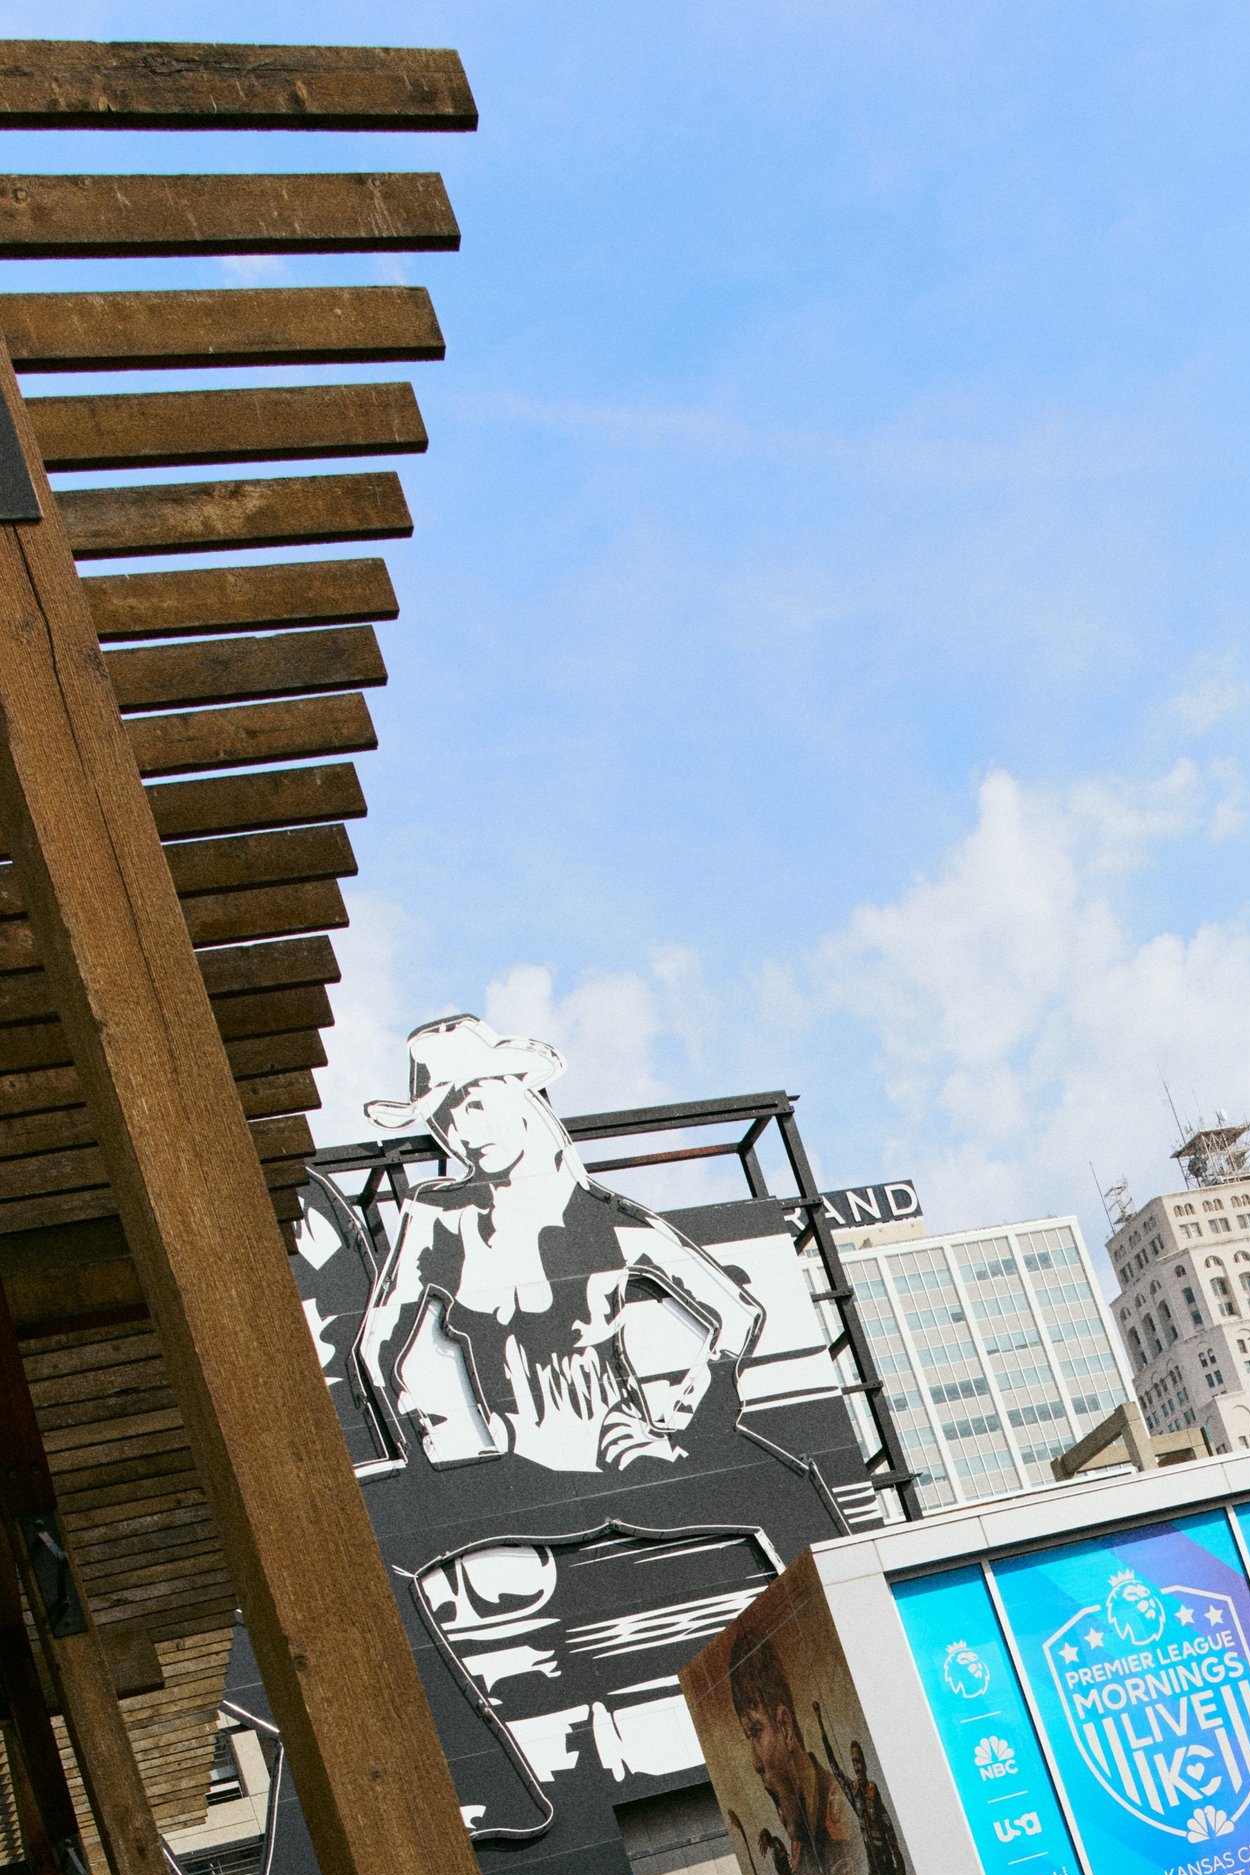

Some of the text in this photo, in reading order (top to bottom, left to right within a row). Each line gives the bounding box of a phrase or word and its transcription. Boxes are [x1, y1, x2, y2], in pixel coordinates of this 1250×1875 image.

[1065, 1630, 1235, 1690] PREMIER LEAGUE
[1073, 1652, 1244, 1719] MORNINGS
[1120, 1689, 1223, 1749] LIVE
[979, 1759, 1018, 1782] NBC
